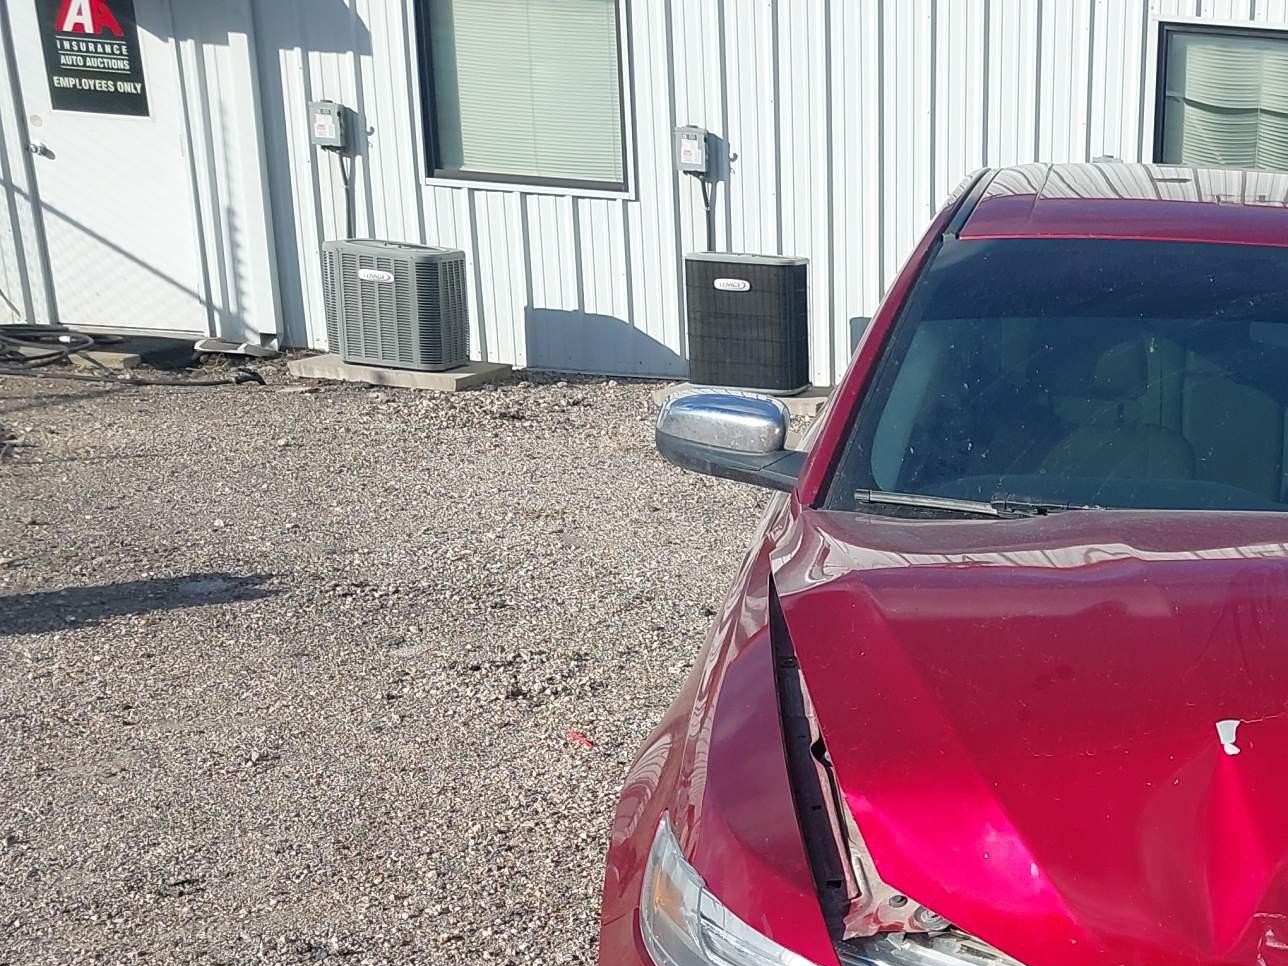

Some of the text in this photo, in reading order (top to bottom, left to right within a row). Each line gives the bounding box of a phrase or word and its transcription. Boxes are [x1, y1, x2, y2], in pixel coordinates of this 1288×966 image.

[56, 40, 129, 55] INSURANCE
[60, 54, 130, 70] AUTO AUCTIONS
[53, 76, 142, 94] EMPLOYEES ONLY
